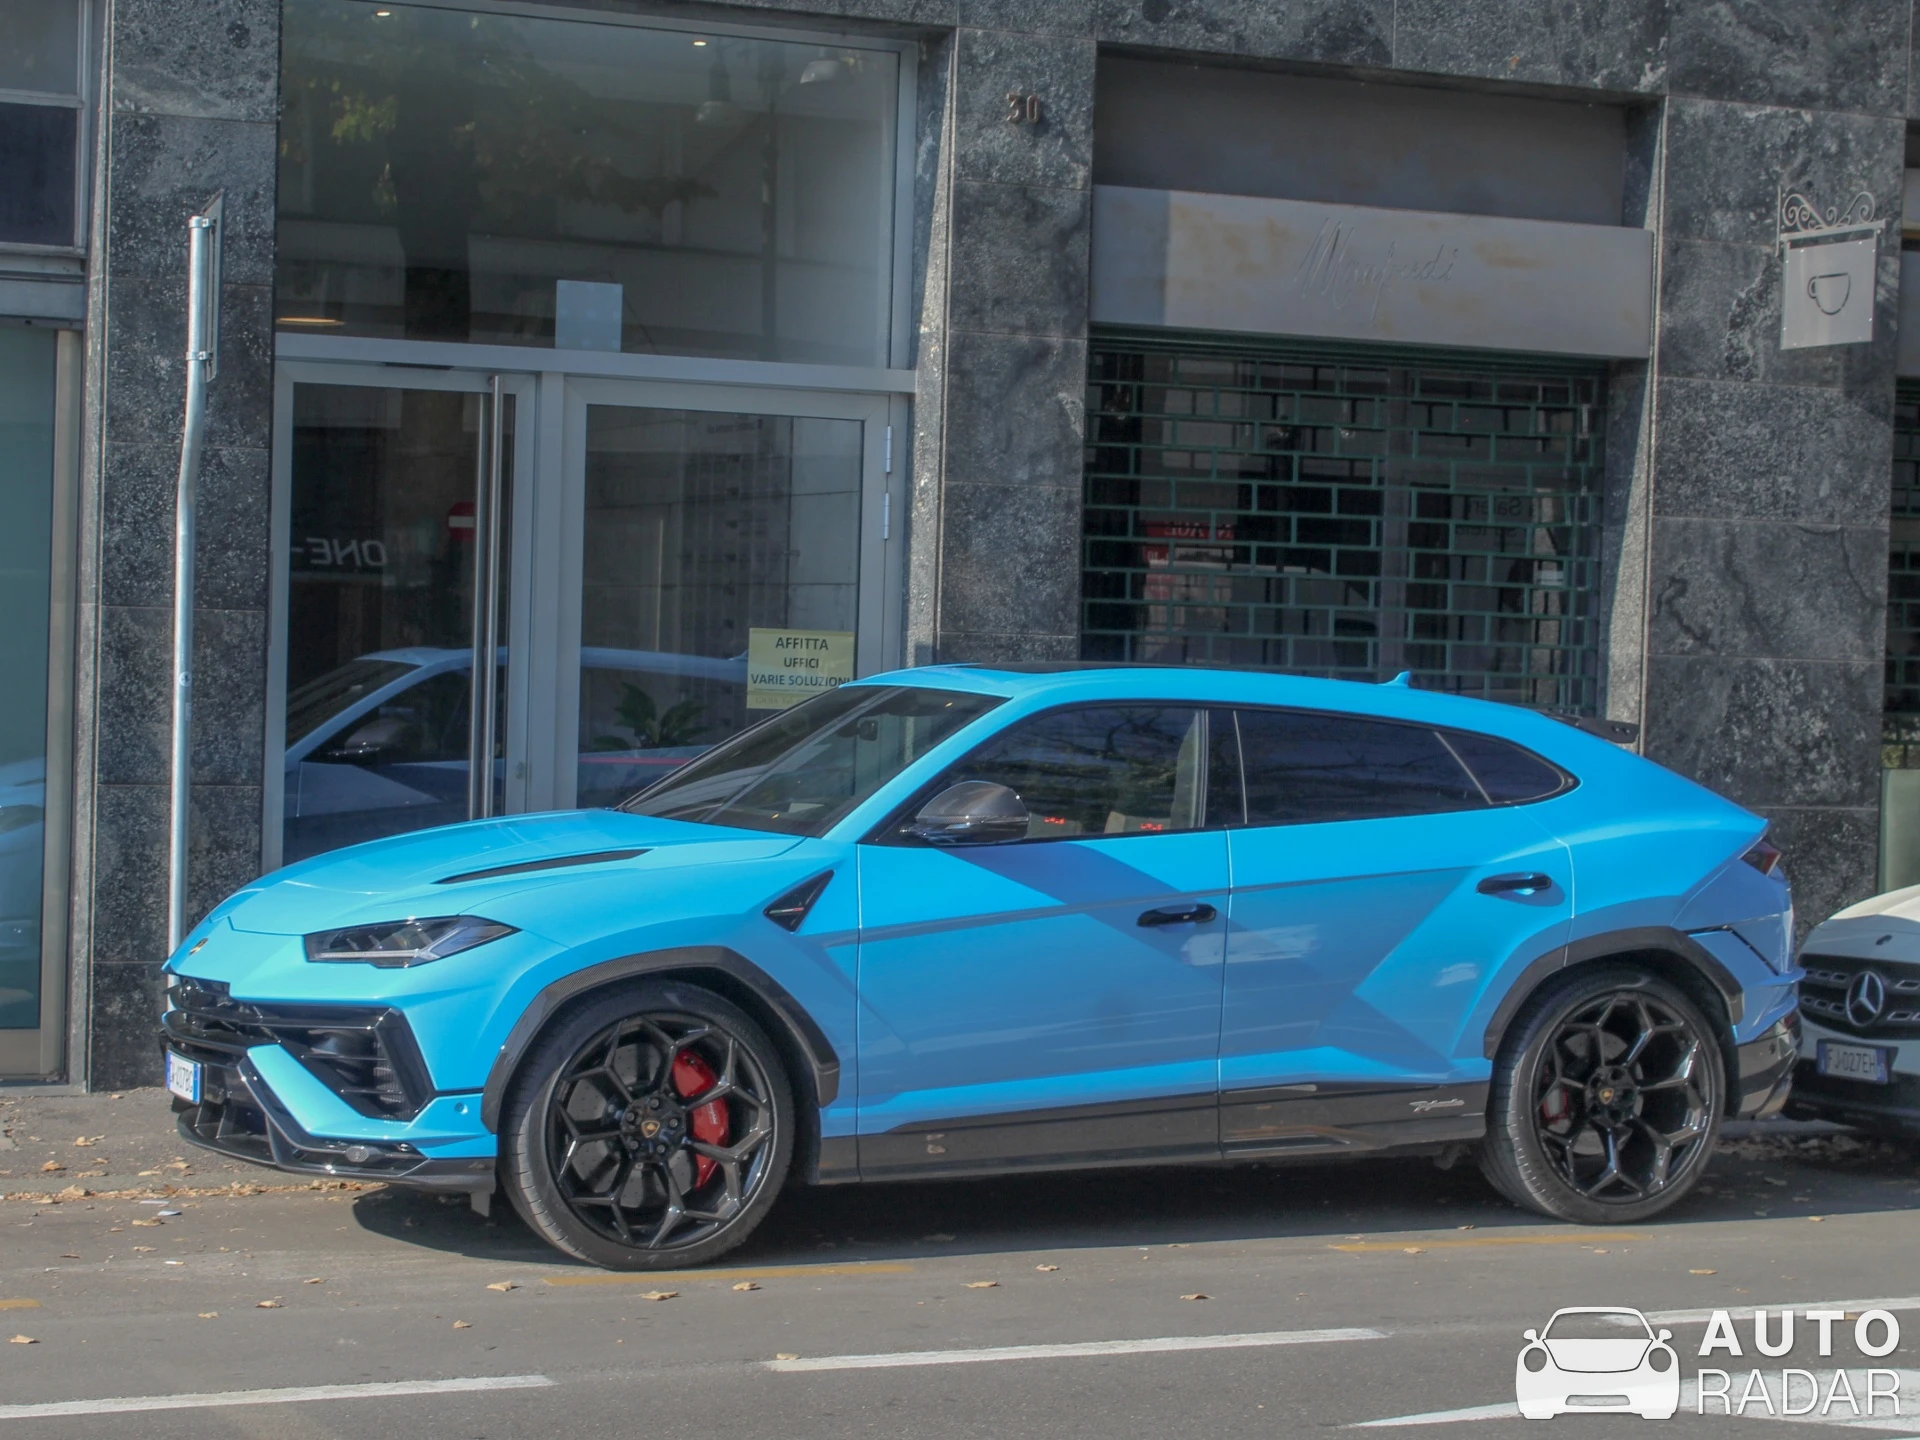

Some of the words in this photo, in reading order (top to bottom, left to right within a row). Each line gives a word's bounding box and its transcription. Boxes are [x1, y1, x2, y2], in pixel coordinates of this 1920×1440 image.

[1006, 93, 1040, 123] 30
[775, 637, 829, 651] AFFITTA
[783, 657, 819, 669] UFFICI
[750, 674, 785, 686] VARIE
